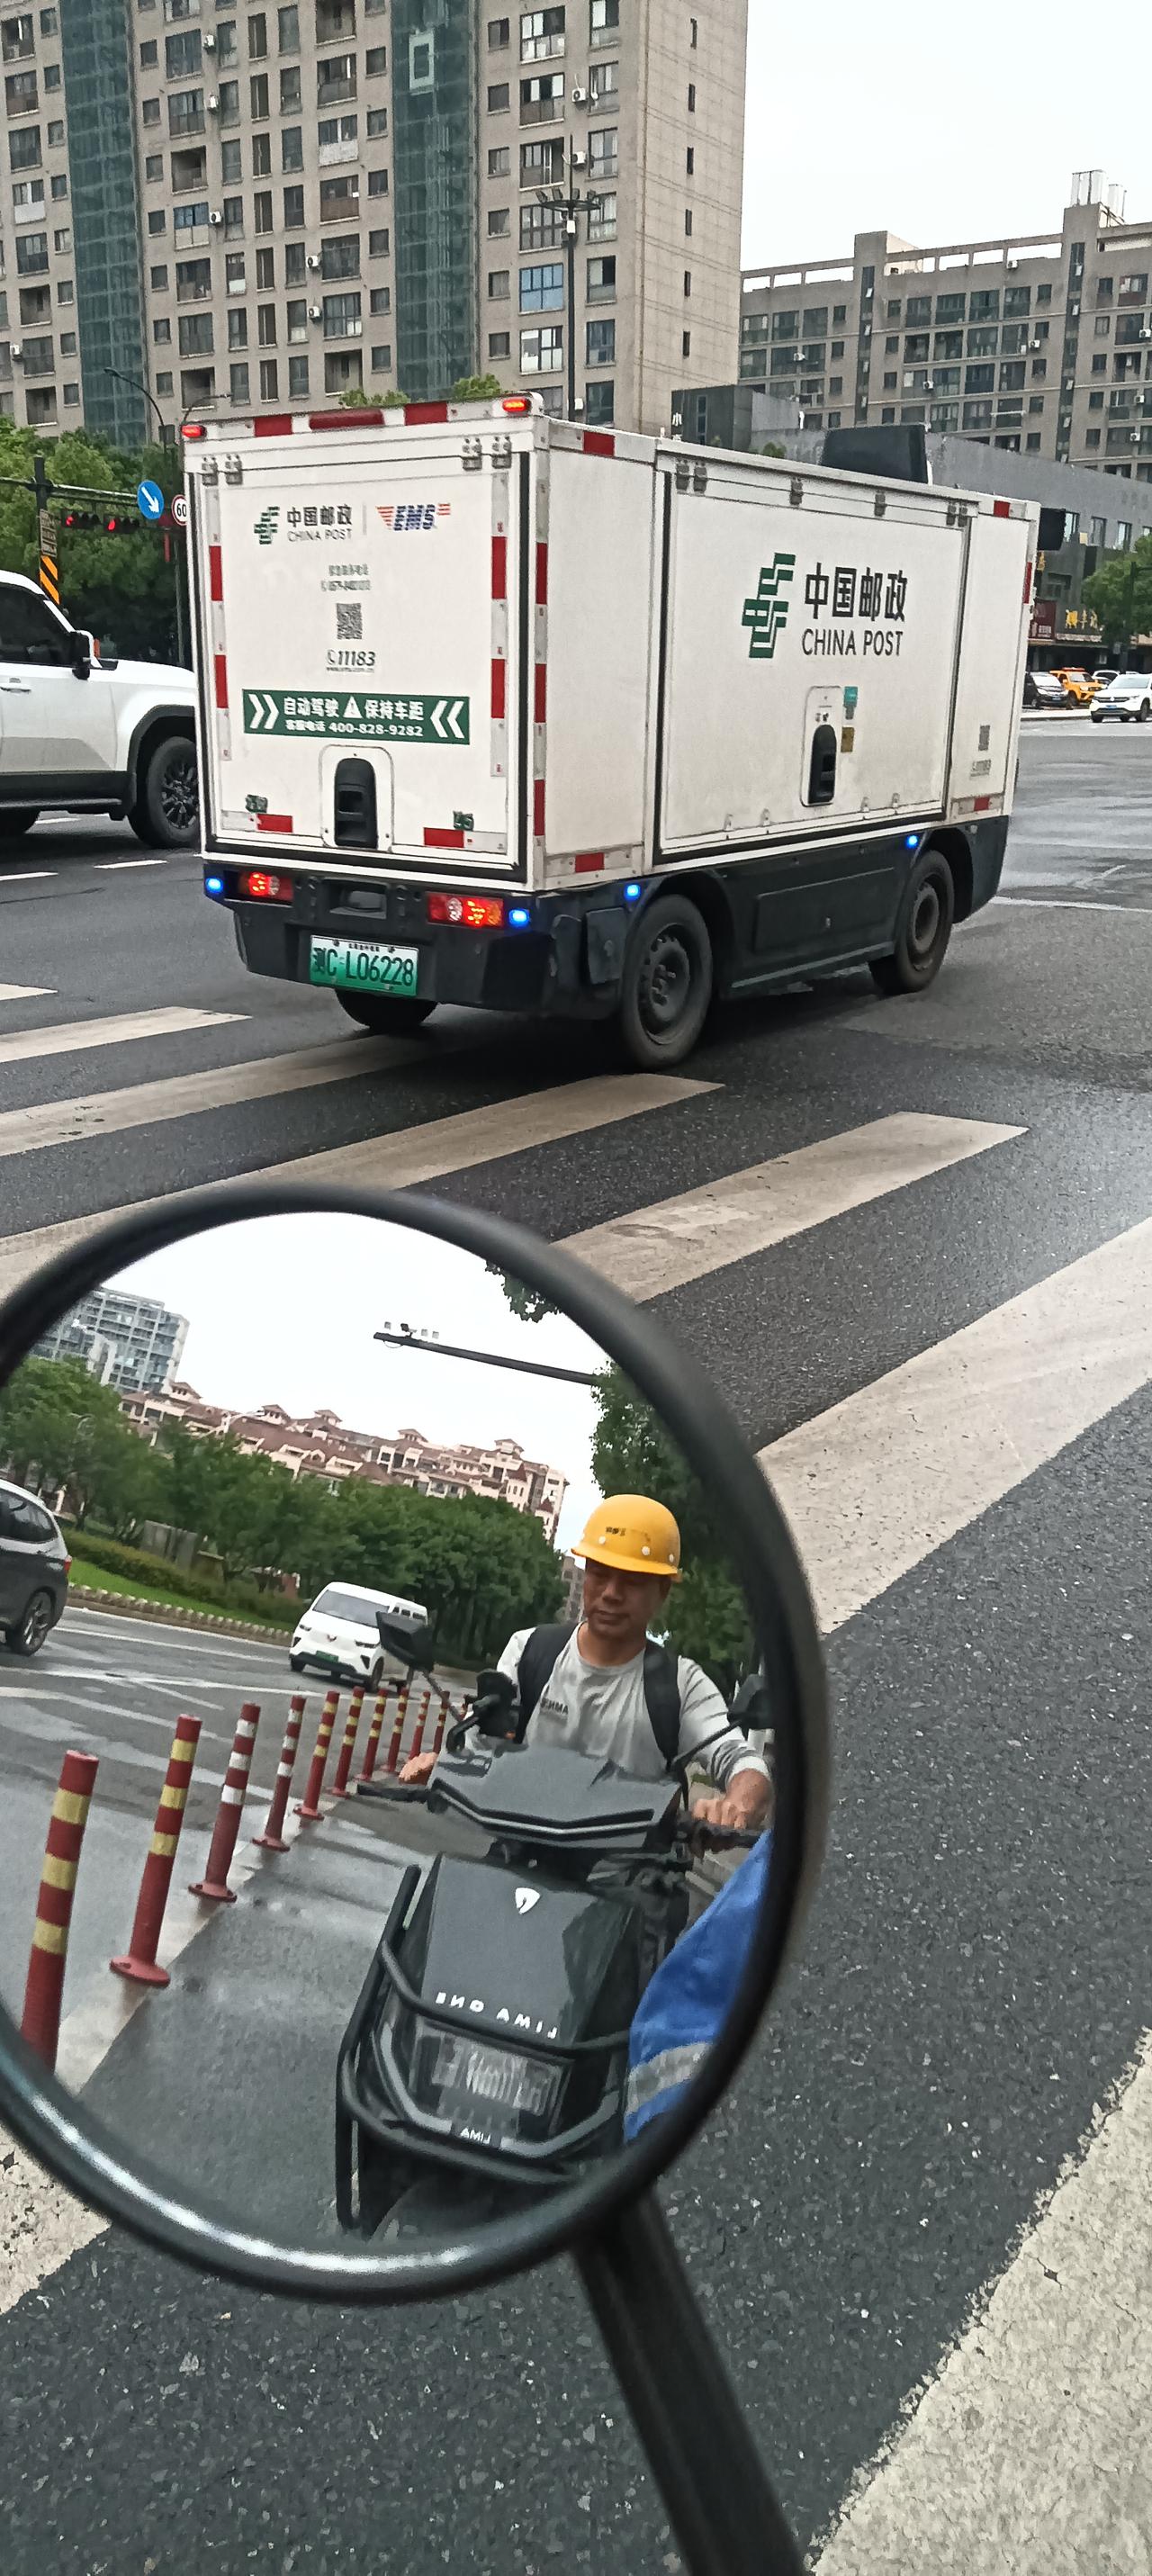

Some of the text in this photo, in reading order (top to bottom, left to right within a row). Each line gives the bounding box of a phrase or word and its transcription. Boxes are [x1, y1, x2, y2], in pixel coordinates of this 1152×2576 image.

[287, 504, 353, 528] 中国邮政
[393, 504, 436, 531] EMS
[805, 562, 907, 622] 中国邮政
[802, 628, 904, 656] CHINA POST
[338, 650, 376, 667] 11183
[284, 697, 424, 721] 自动驾驶 保持车距
[328, 722, 424, 737] 400-828-9282
